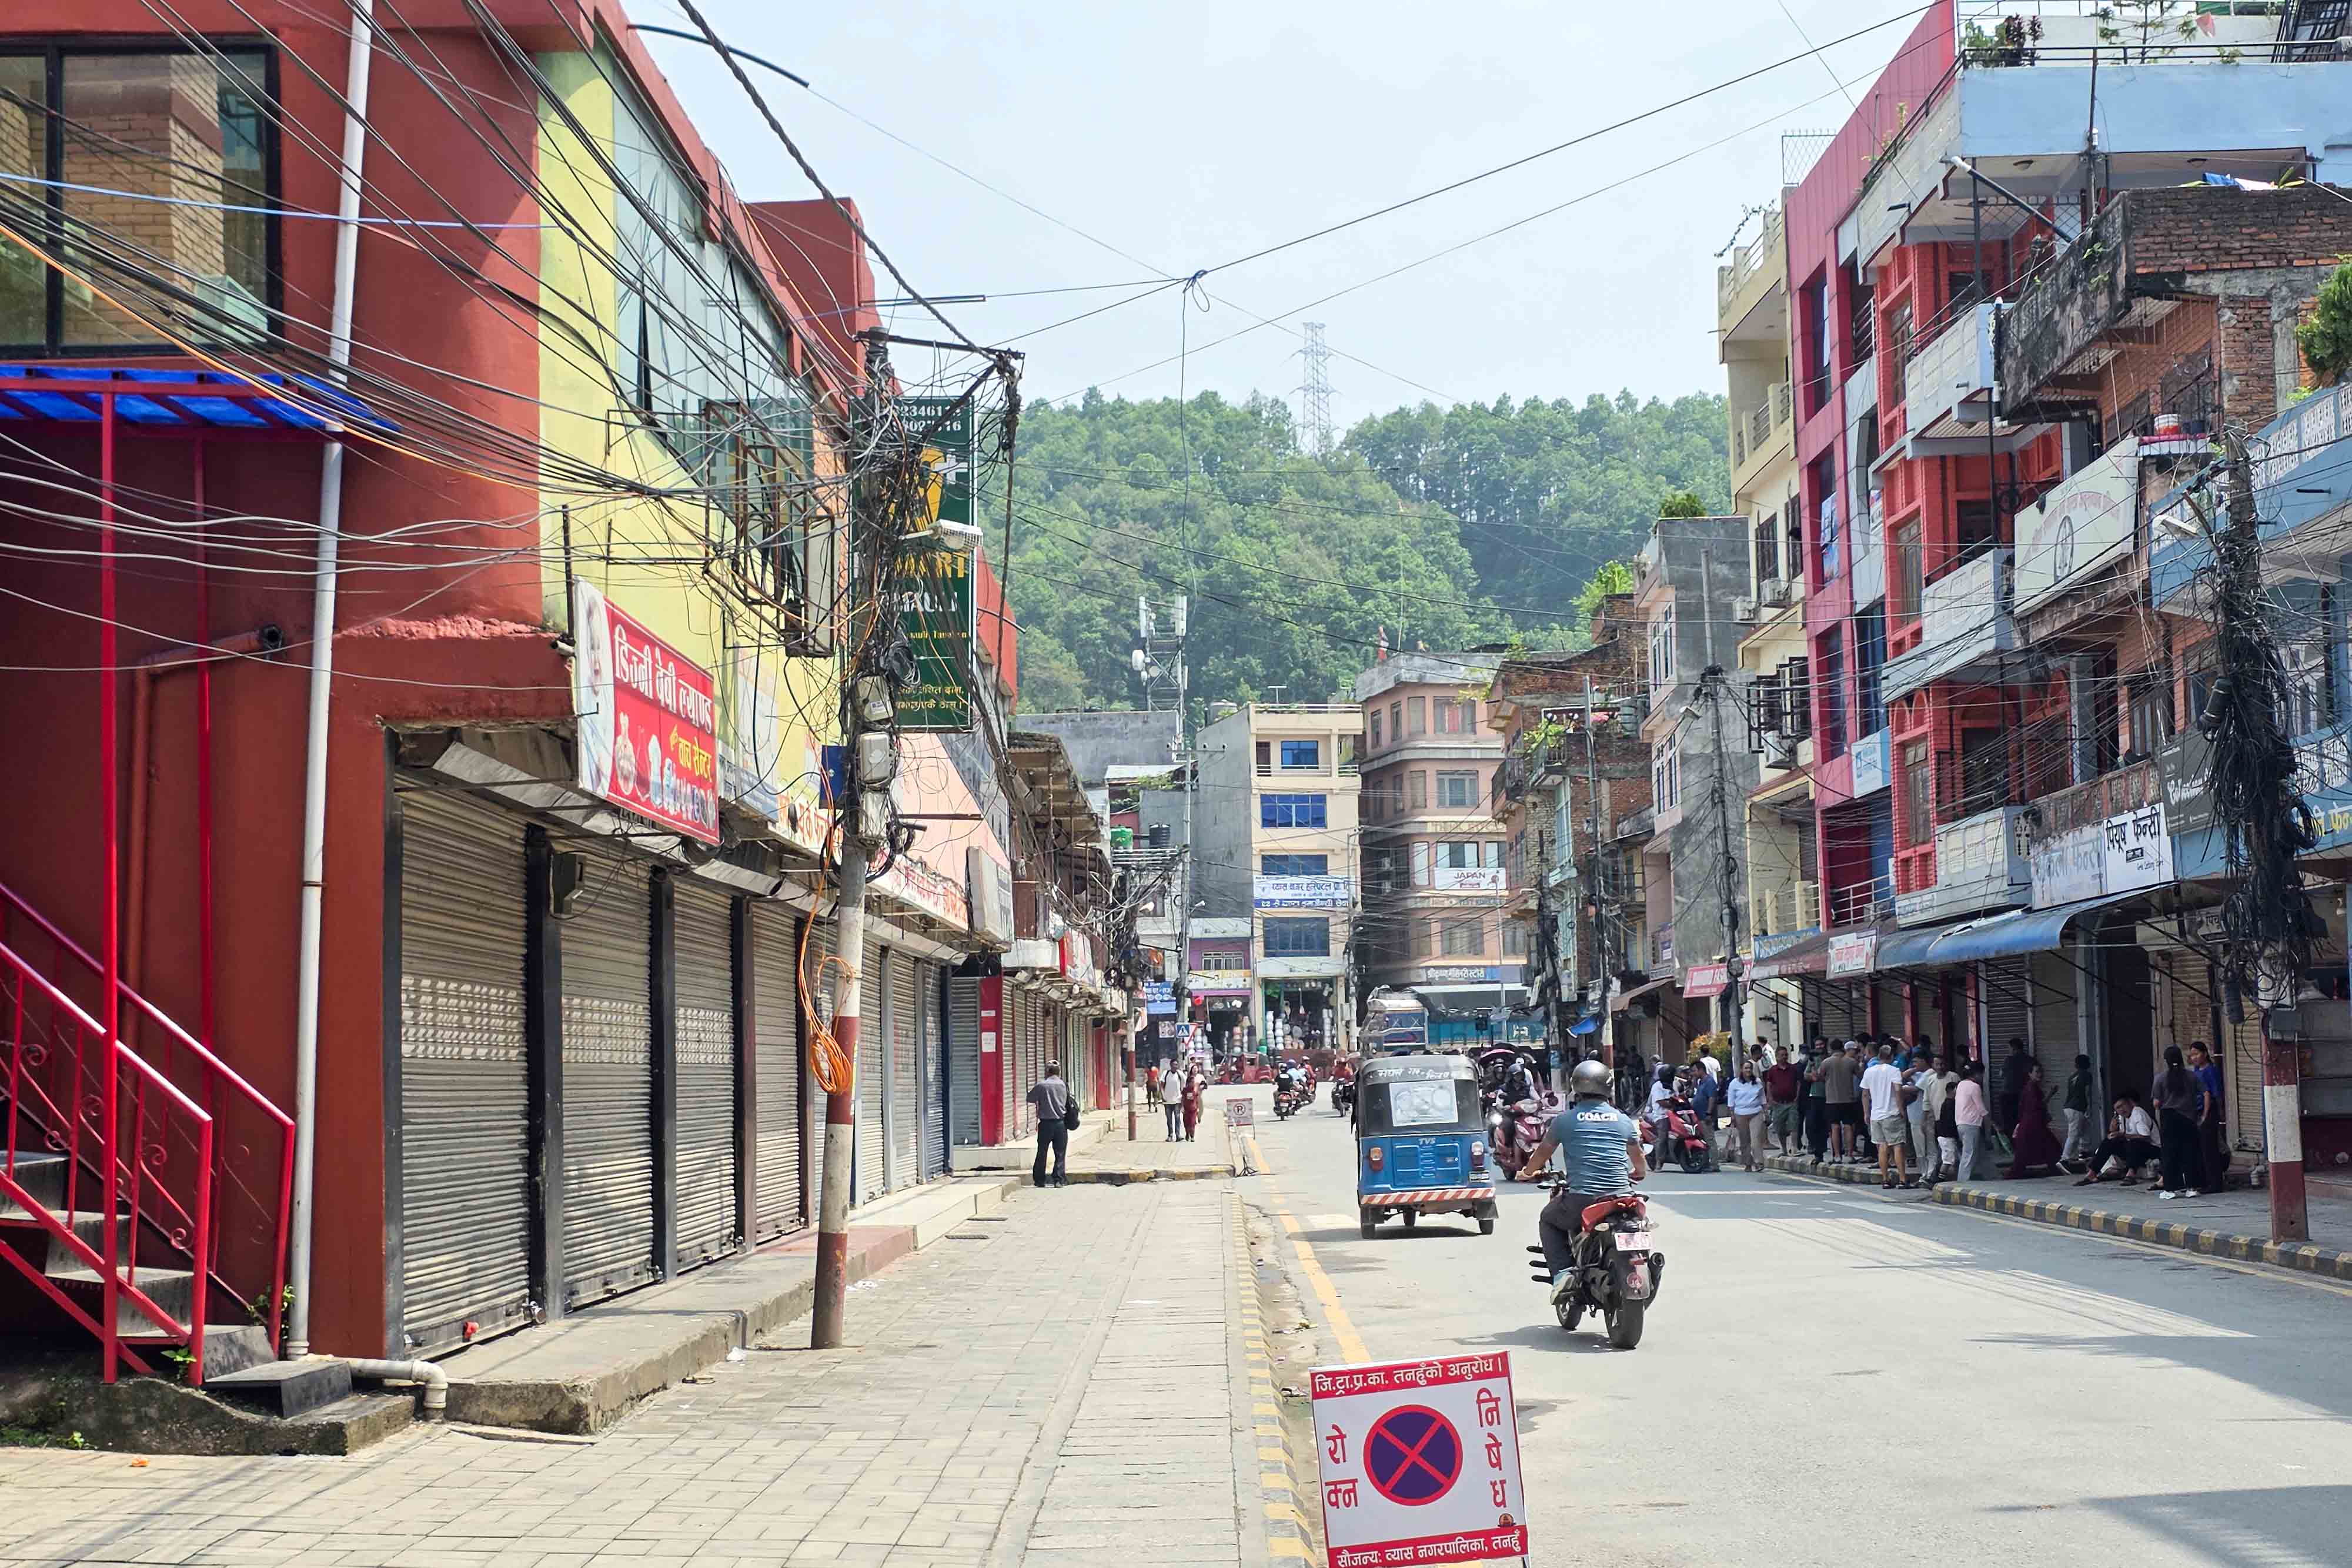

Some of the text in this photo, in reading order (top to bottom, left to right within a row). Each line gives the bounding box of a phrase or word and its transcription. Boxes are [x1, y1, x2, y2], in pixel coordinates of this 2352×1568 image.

[1577, 1112, 1618, 1121] COACH
[1315, 1374, 1388, 1396] जि.ट्रा.प्र.का.
[1393, 1361, 1443, 1386] तनहुँको
[1448, 1357, 1493, 1380] अनुरोध
[1337, 1529, 1522, 1568] सौजन्य: व्यास नगरपालिका, तनहुँ
